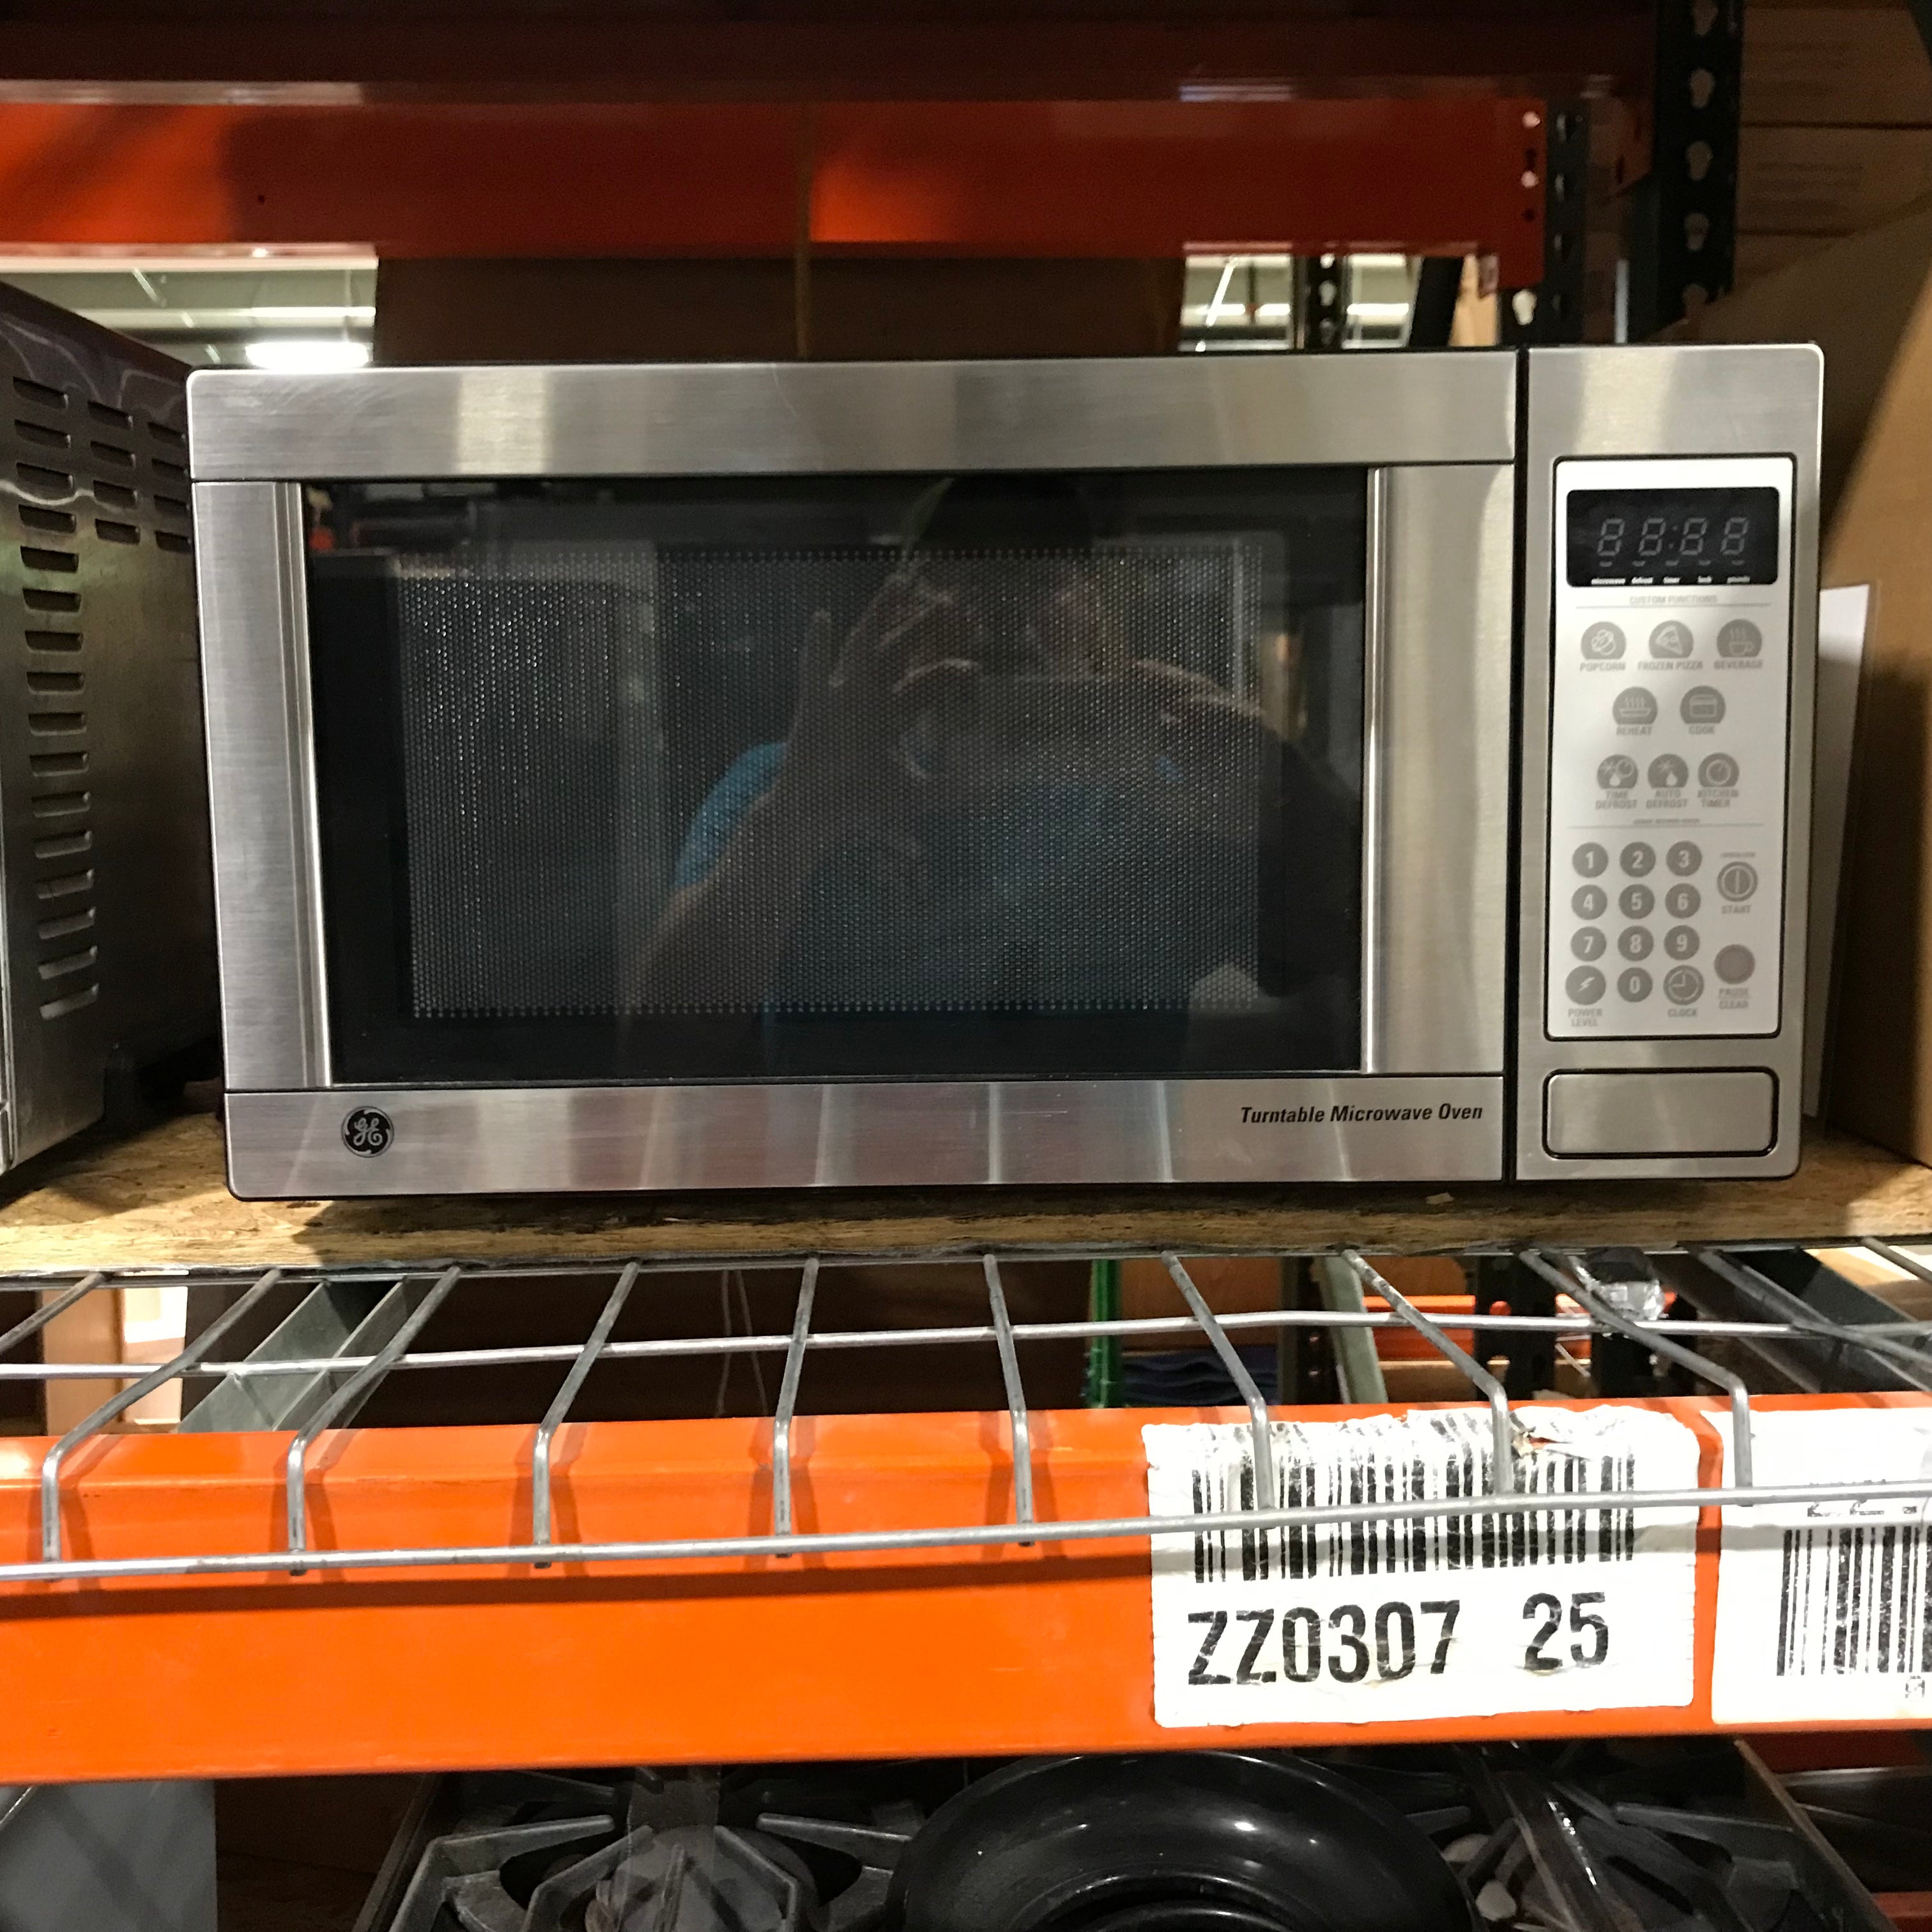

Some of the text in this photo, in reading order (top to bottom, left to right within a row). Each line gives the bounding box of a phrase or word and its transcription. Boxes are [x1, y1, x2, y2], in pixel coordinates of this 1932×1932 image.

[1580, 662, 1625, 671] POPCORN
[1638, 661, 1702, 670] FROZEN PIZZA
[1714, 659, 1763, 669] BEVERAGE
[1616, 726, 1652, 735] REHEAT
[1689, 725, 1714, 735] COOK
[1606, 790, 1628, 799] TIME
[1655, 790, 1680, 798] AUTO
[1596, 800, 1637, 809] DEFROST
[1646, 799, 1688, 808] DEFROST
[1585, 850, 1689, 868] 1 2 3
[1583, 893, 1688, 910] 4 5 6
[1721, 905, 1751, 914] START
[1584, 935, 1687, 953] 7 8 9
[1629, 976, 1640, 993] 0
[1719, 989, 1749, 998] PAUSE
[1719, 1000, 1749, 1009] CLEAR
[1568, 1008, 1602, 1017] POWER
[1668, 1008, 1698, 1017] CLOCK
[1571, 1018, 1598, 1027] LEVEL
[1241, 1102, 1483, 1123] Turntable Microwave Oven
[1187, 1591, 1609, 1686] ZZ0307 25
